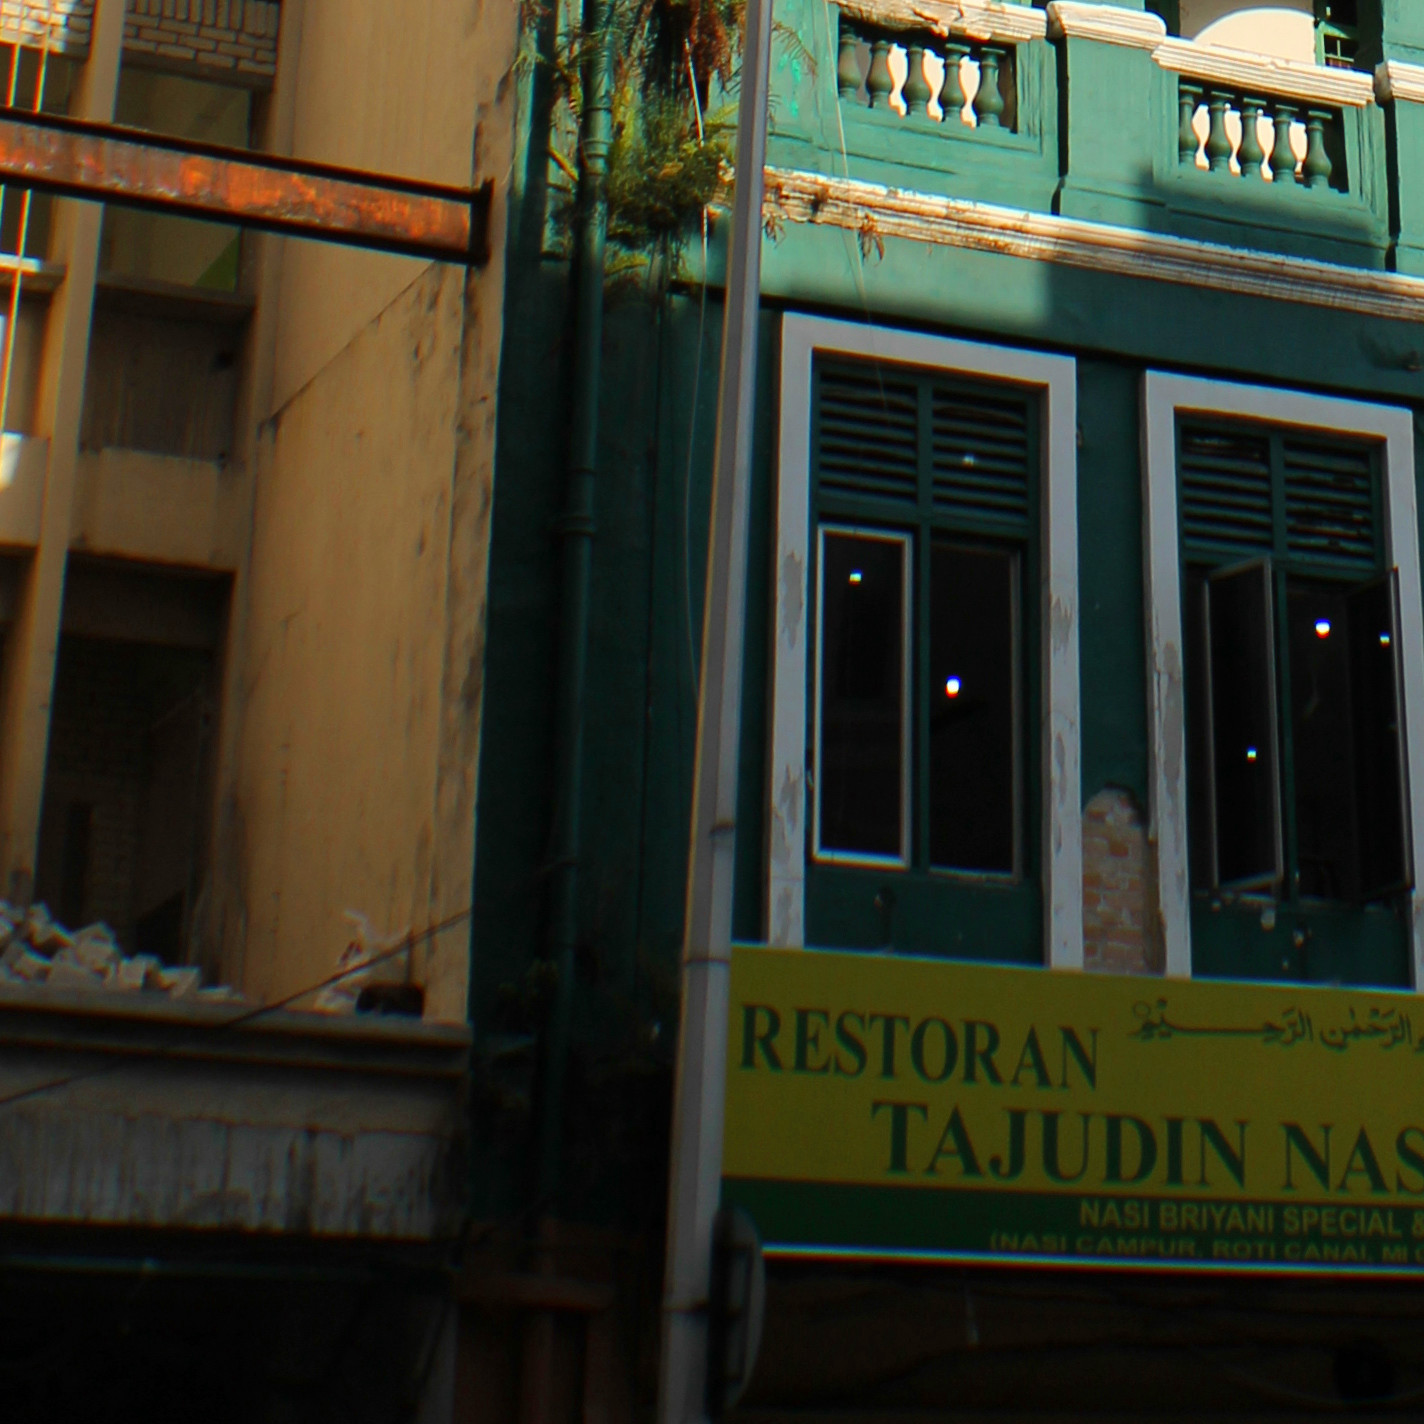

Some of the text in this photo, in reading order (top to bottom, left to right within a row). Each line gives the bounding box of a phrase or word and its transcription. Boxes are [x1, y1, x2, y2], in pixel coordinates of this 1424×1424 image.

[740, 1004, 1100, 1090] RESTORAN
[872, 1100, 1248, 1189] TAJUDIN
[988, 1231, 1068, 1254] (NASI
[1211, 1239, 1277, 1261] ROTI
[1380, 1245, 1409, 1264] MI
[1078, 1198, 1151, 1231] NASI
[1158, 1201, 1275, 1235] BRIYANI
[1282, 1206, 1403, 1239] SPECIAL
